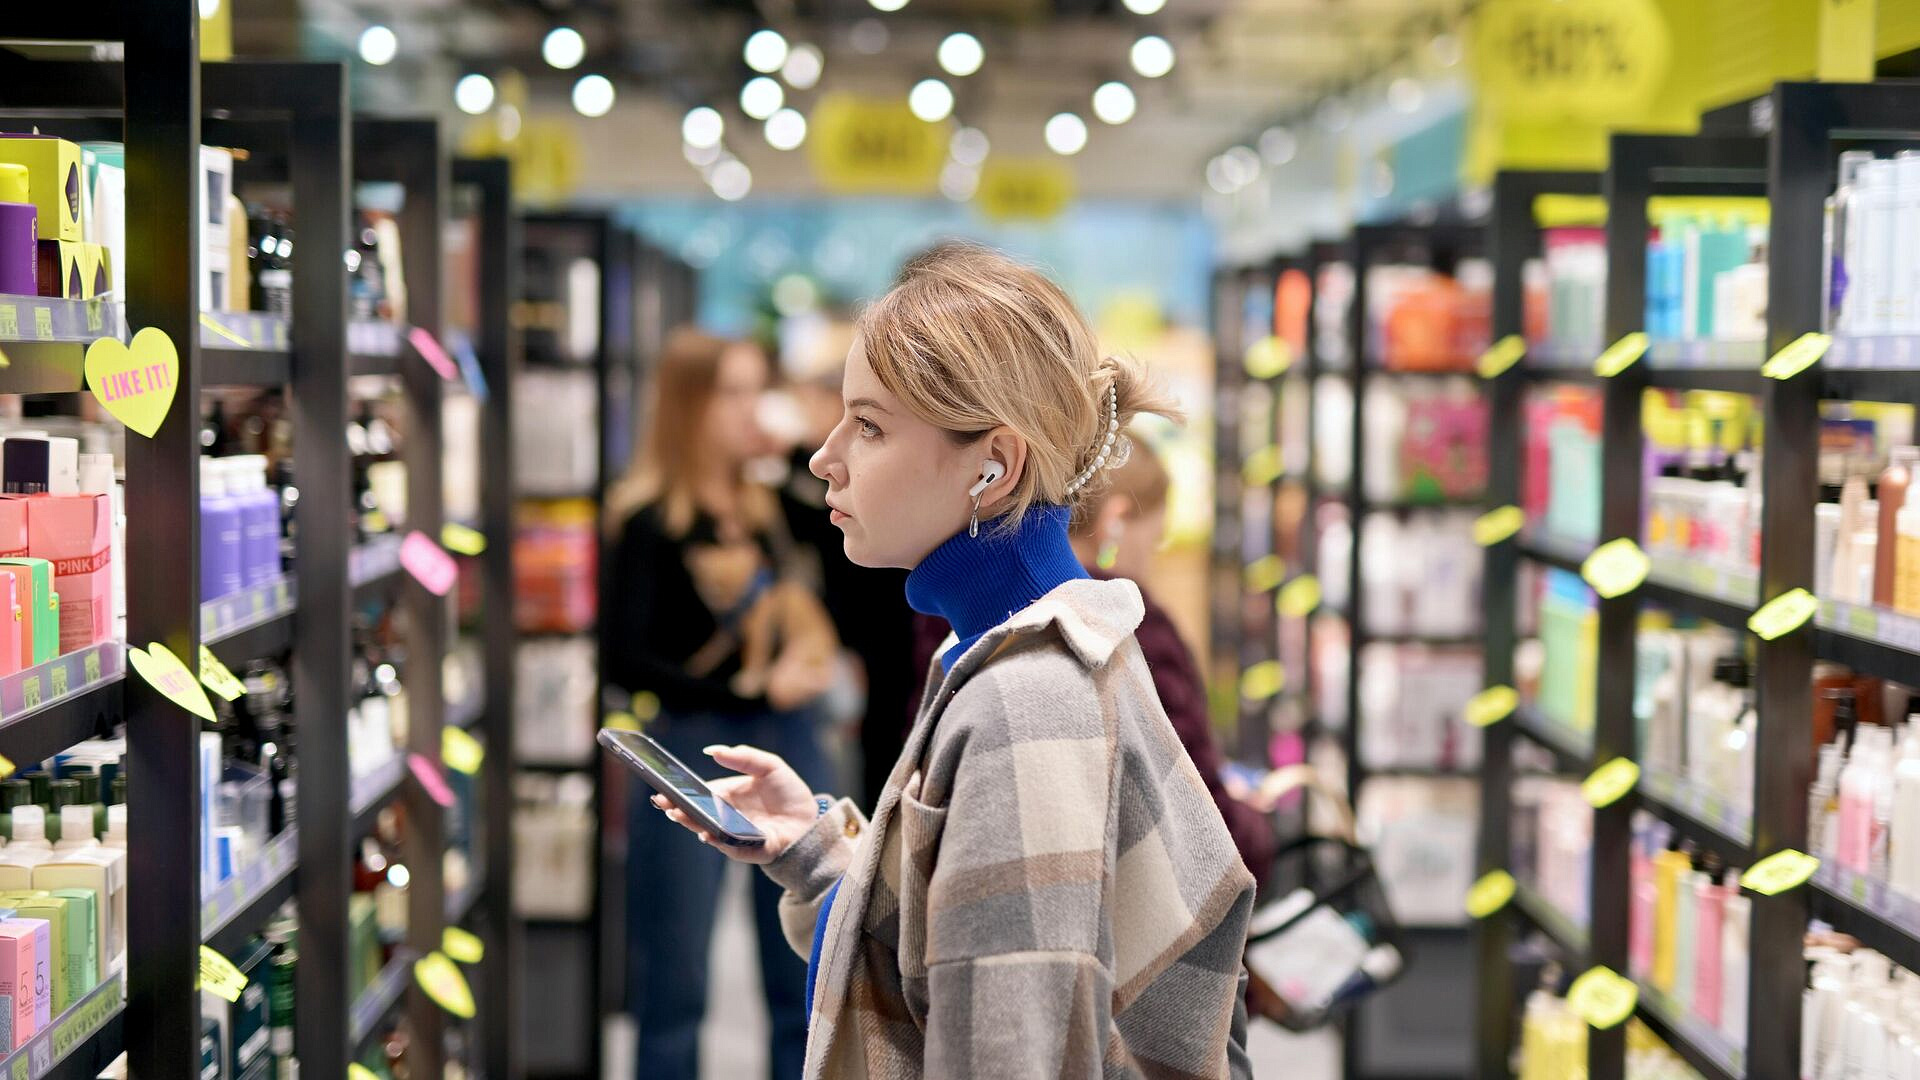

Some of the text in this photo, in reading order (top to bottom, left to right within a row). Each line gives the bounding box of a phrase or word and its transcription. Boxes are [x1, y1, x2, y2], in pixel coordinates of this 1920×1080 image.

[101, 363, 171, 402] LIKE IT!
[58, 558, 91, 574] PINK
[20, 971, 29, 1007] 5
[35, 961, 45, 996] 5
